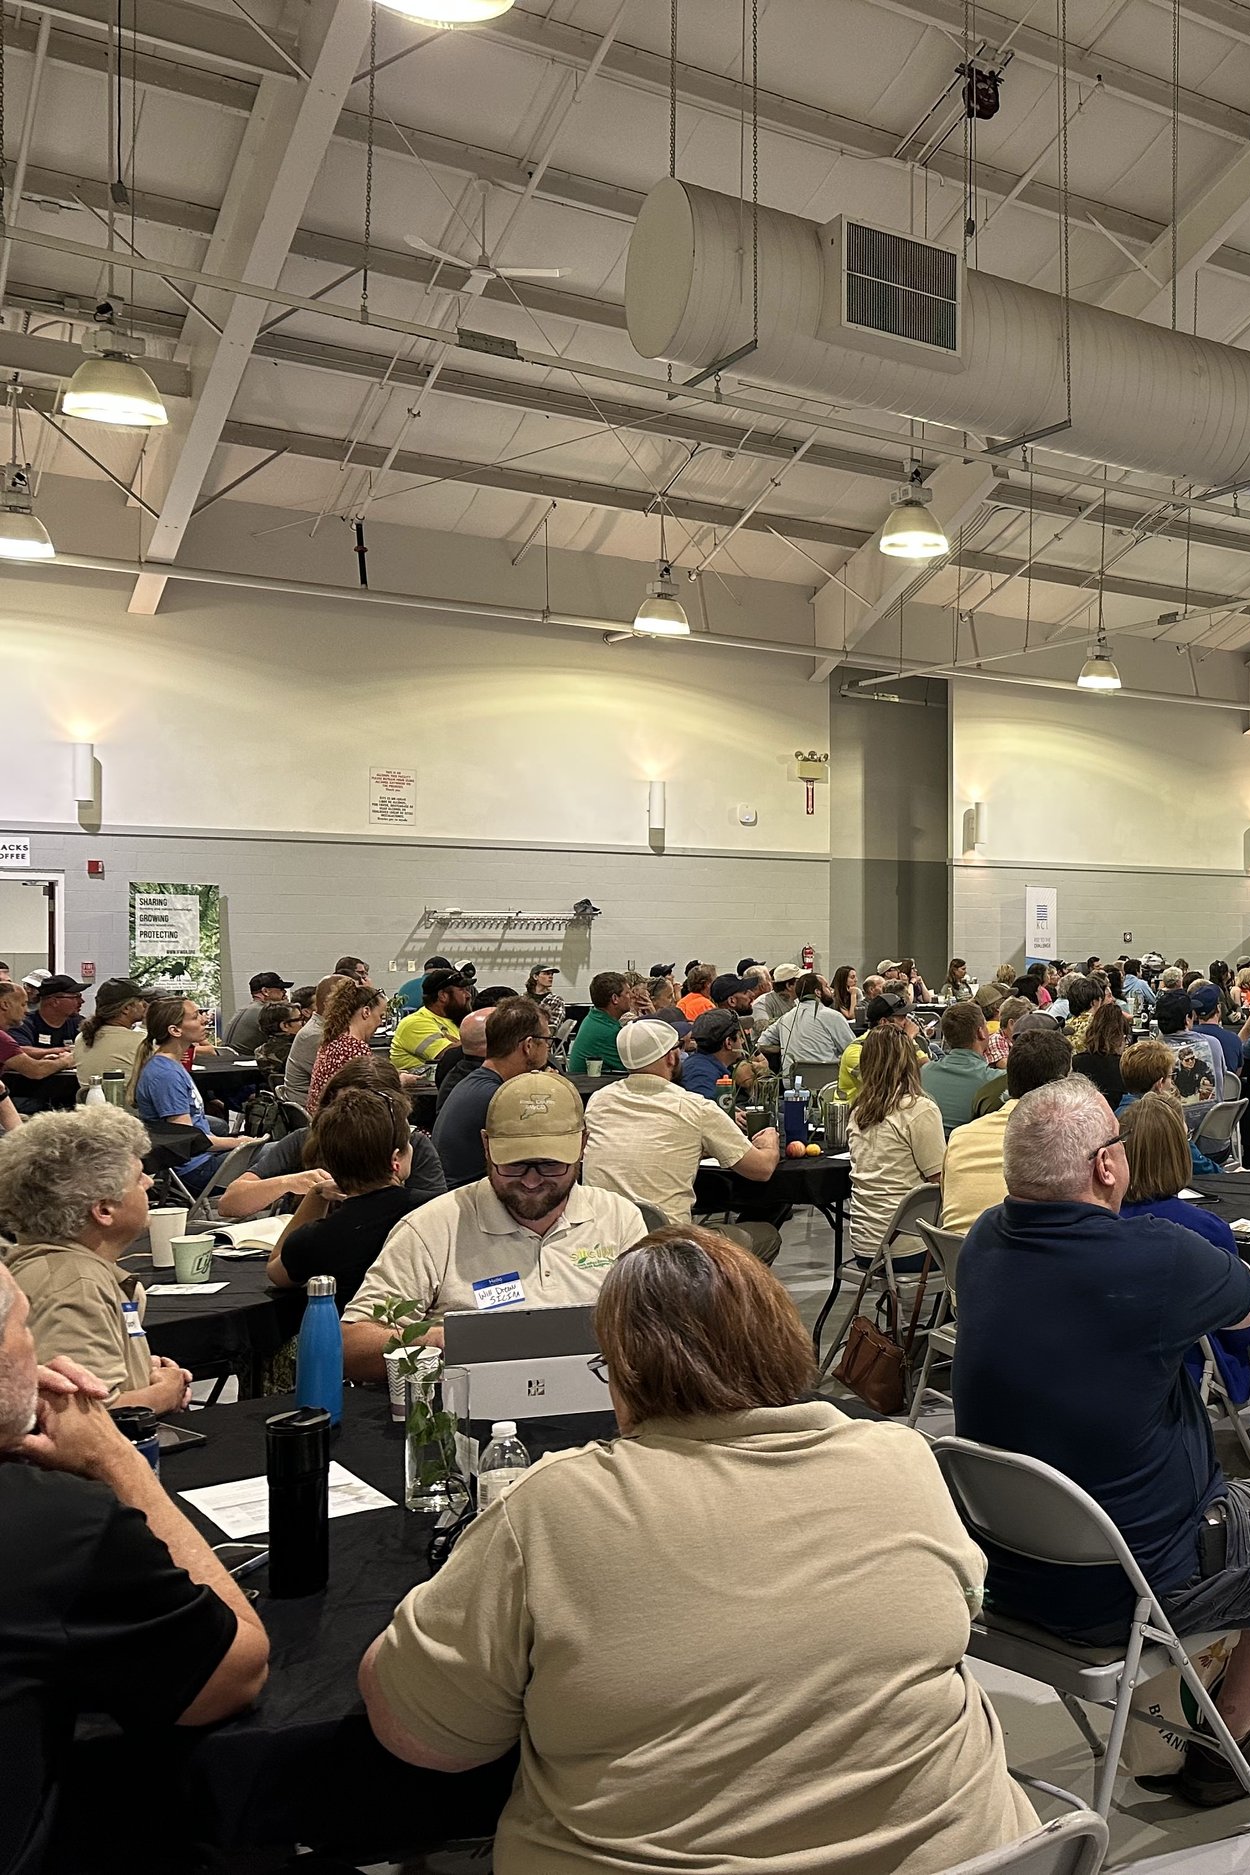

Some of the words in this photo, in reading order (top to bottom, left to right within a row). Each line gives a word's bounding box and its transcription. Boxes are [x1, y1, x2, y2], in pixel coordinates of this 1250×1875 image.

[139, 898, 168, 906] SHARING
[139, 914, 169, 922] GROWING
[139, 931, 178, 939] PROTECTING
[478, 1289, 493, 1300] Will
